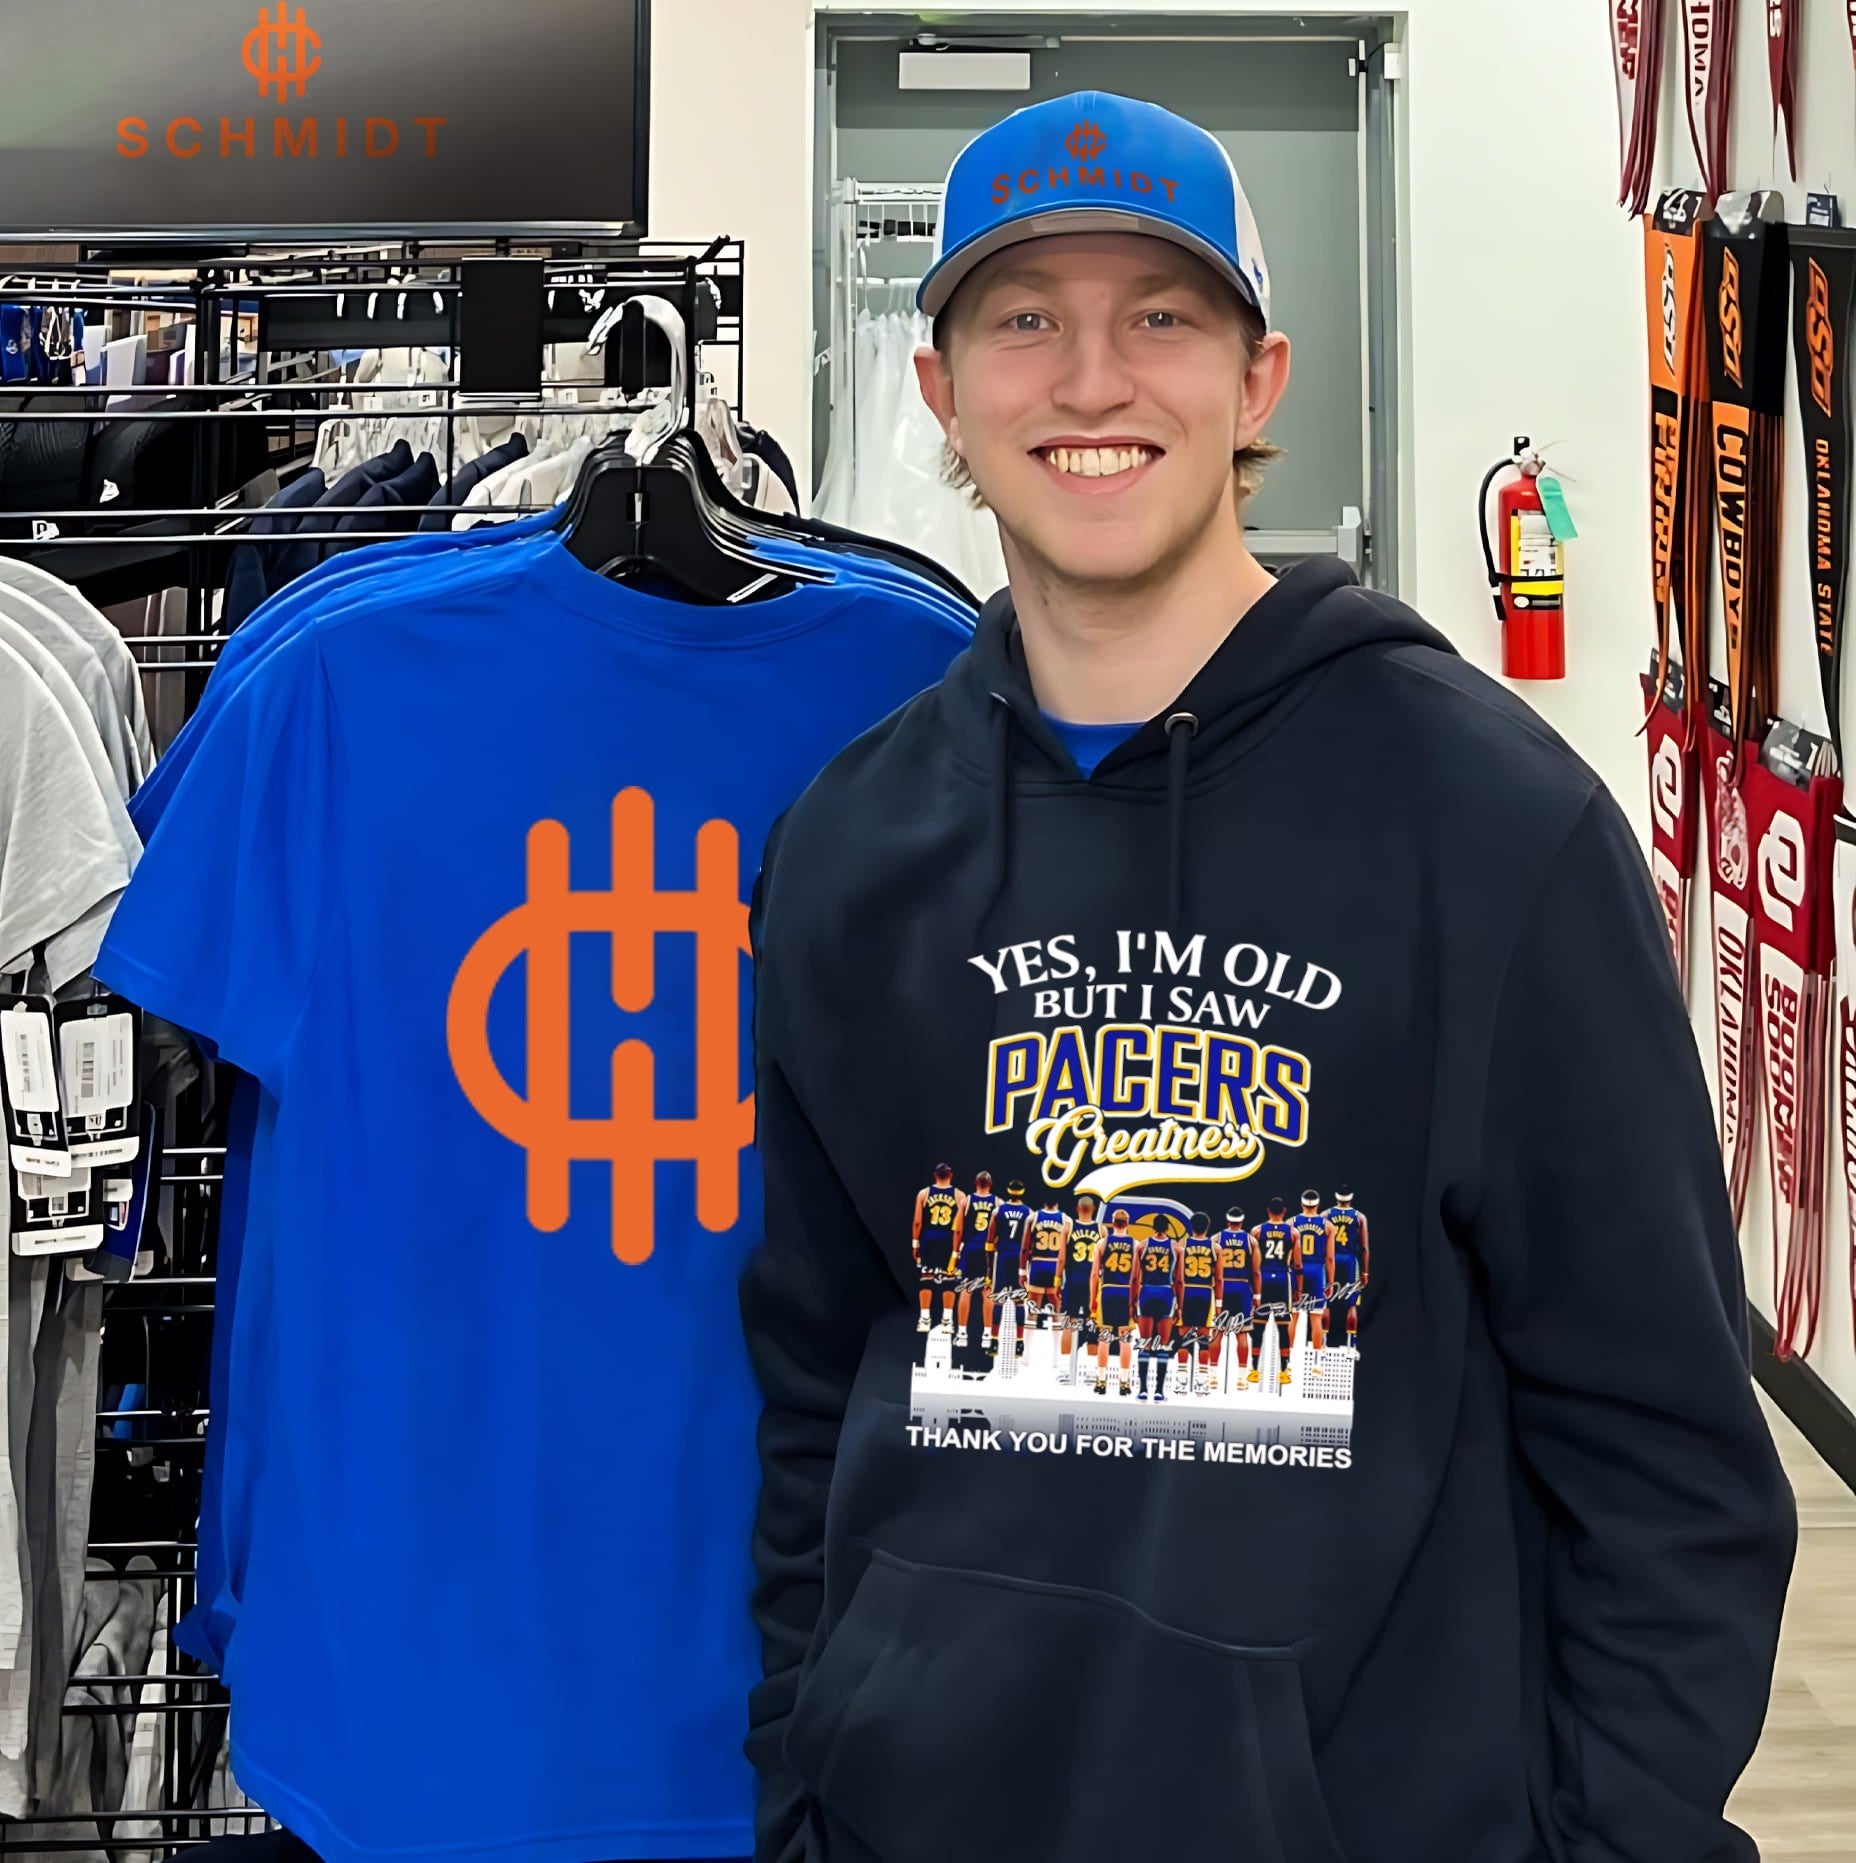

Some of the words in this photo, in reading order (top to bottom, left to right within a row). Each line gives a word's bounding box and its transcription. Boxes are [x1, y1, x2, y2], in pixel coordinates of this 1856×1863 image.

[116, 117, 447, 158] SCHMIDT
[991, 167, 1179, 205] SCHMIDT
[968, 934, 1097, 995] YES,
[1116, 930, 1206, 978] I'M
[1223, 943, 1343, 1011] OLD
[1033, 984, 1127, 1019] BUT
[1139, 985, 1152, 1020] I
[1167, 988, 1271, 1029] SAW
[984, 1023, 1311, 1147] PACERS
[1026, 1105, 1266, 1198] Greatness
[930, 1205, 952, 1226] 13
[974, 1212, 988, 1231] 5
[1008, 1220, 1018, 1239] 7
[1071, 1229, 1101, 1242] MILLER
[1036, 1231, 1061, 1251] 30
[1073, 1241, 1095, 1262] 31
[1265, 1239, 1285, 1260] 24
[1302, 1234, 1315, 1256] 0
[1105, 1253, 1132, 1273] 45
[1146, 1254, 1170, 1273] 34
[1185, 1256, 1211, 1278] 35
[1222, 1249, 1246, 1269] 23
[906, 1425, 1001, 1452] THANK
[1009, 1429, 1069, 1456] YOU
[1076, 1436, 1132, 1460] FOR
[1141, 1438, 1196, 1462] THE
[1203, 1441, 1353, 1469] MEMORIES
